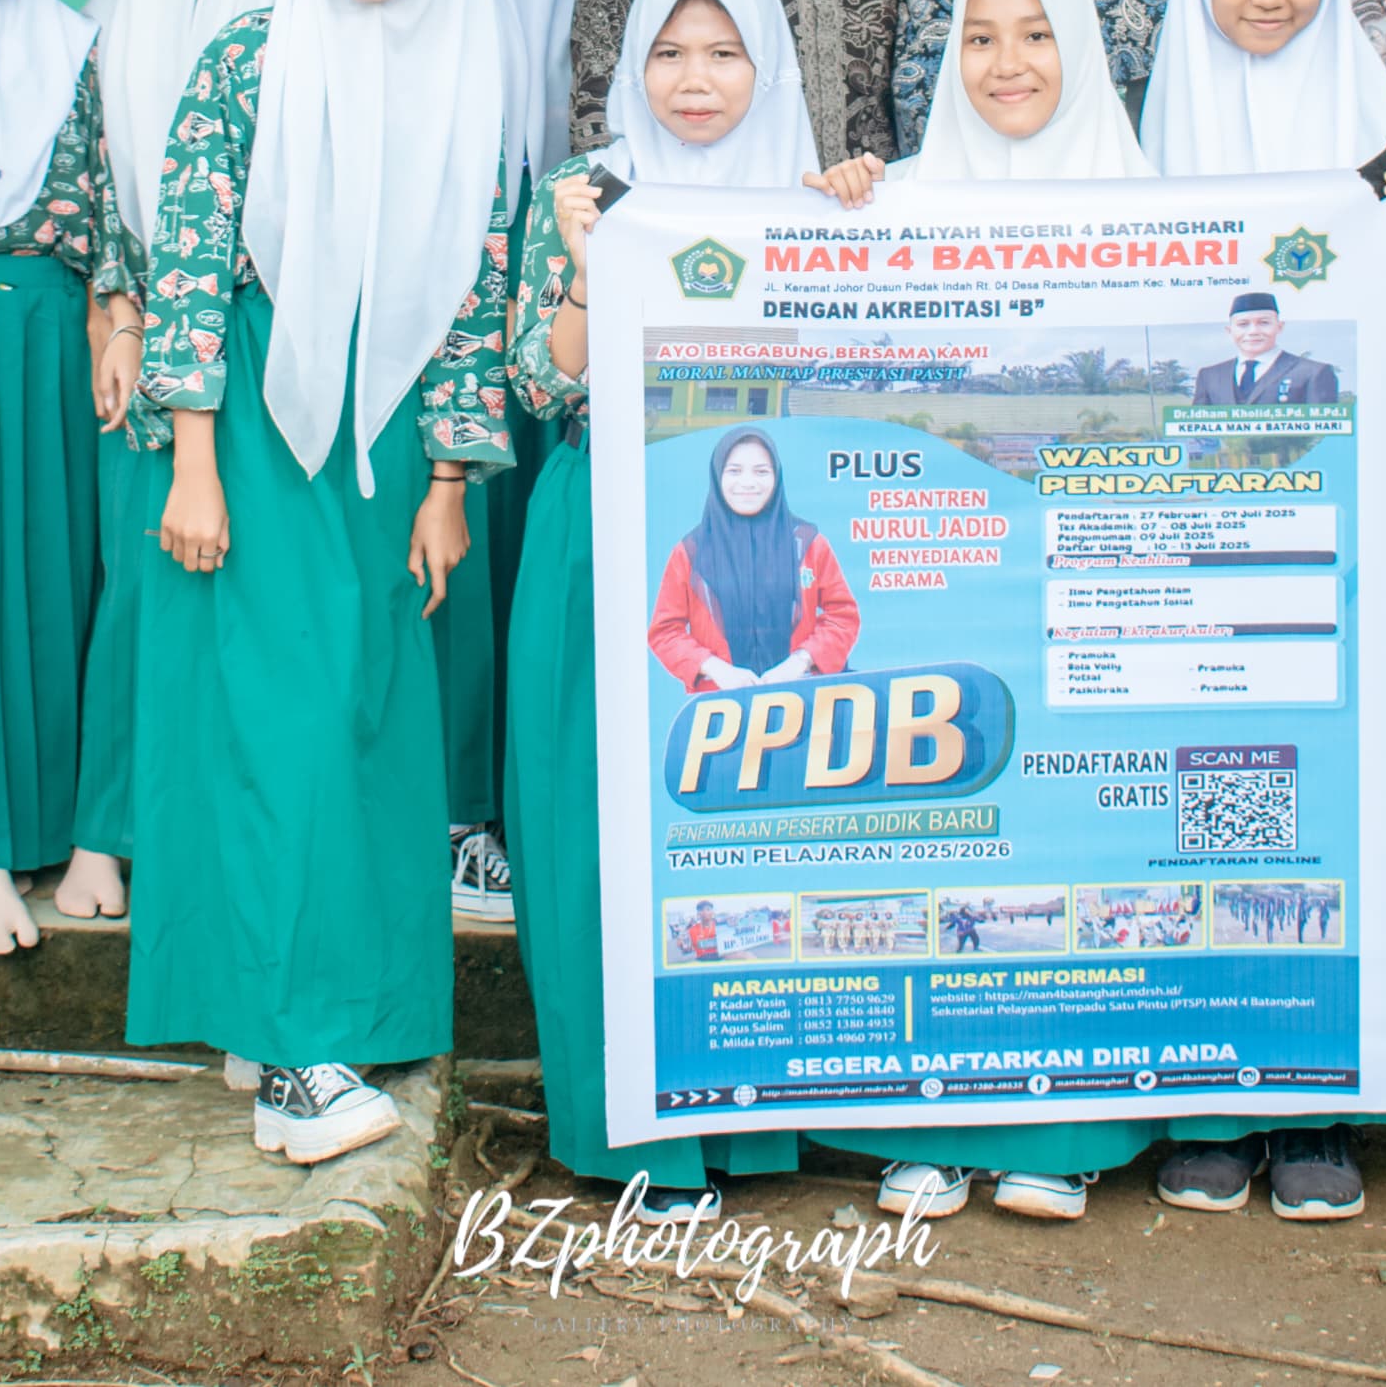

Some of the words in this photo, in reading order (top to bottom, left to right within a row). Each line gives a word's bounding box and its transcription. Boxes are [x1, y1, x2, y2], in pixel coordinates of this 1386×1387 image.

[765, 227, 892, 241] MADRASAH
[899, 226, 981, 240] ALIYAH
[989, 224, 1072, 239] NEGERI
[1080, 223, 1093, 237] 4
[1101, 220, 1245, 237] BATANGHARI
[765, 245, 869, 272] MAN
[886, 245, 915, 271] 4
[933, 239, 1239, 271] BATANGHARI
[784, 283, 830, 293] Keramat
[833, 282, 863, 293] Johor
[867, 282, 901, 293] Dusun
[943, 281, 972, 291] Indah
[995, 281, 1008, 291] 04
[1012, 280, 1039, 291] Desa
[1043, 279, 1098, 290] Rambutan
[1101, 278, 1140, 289] Masam
[1144, 277, 1165, 288] Kec.
[1170, 276, 1203, 287] Muara
[763, 300, 858, 319] DENGAN
[865, 299, 1001, 319] AKREDITASI
[659, 345, 700, 359] AYO
[706, 345, 829, 359] BERGABUNG
[835, 345, 931, 360] BERSAMA
[936, 346, 989, 359] KAMI
[658, 366, 728, 381] MORAL
[732, 366, 814, 381] MANTAP
[818, 366, 906, 381] PRESTASI
[910, 366, 965, 381] PASTI
[1178, 423, 1223, 433] KEPALA
[1226, 423, 1251, 432] MAN
[1254, 423, 1262, 431] 4
[1265, 422, 1311, 432] BATANG
[1315, 421, 1343, 431] HARI
[1040, 446, 1181, 468] WAKTU
[829, 452, 923, 478] PLUS
[1039, 471, 1322, 495] PENDAFTARAN
[869, 490, 987, 509] PESANTREN
[1057, 512, 1130, 521] Pendaftaran
[1139, 511, 1155, 519] 27
[1158, 510, 1208, 519] Februari
[1240, 509, 1262, 518] Juli
[1265, 509, 1297, 518] 2025
[852, 518, 931, 540] NURUL
[937, 517, 1007, 538] JADID
[1190, 521, 1212, 530] Juli
[1215, 521, 1246, 530] 2025
[1159, 532, 1180, 541] Juli
[1184, 531, 1215, 540] 2025
[1057, 543, 1096, 552] Daftar
[1099, 543, 1133, 554] Ulang
[1154, 542, 1168, 551] 10
[1180, 542, 1192, 551] 13
[1195, 541, 1216, 550] Juli
[1219, 541, 1250, 550] 2025
[870, 548, 999, 565] MENYEDIAKAN
[1053, 555, 1116, 568] Program
[870, 572, 945, 588] ASRAMA
[1068, 587, 1093, 596] Ilmu
[1164, 586, 1191, 595] Alam
[1068, 599, 1093, 608] Ilmu
[1068, 651, 1116, 660] Pramuka
[1068, 663, 1091, 671] Bola
[1197, 664, 1246, 673] Pramuka
[1200, 683, 1248, 693] Pramuka
[677, 673, 966, 795] PPDB
[1023, 751, 1168, 775] PENDAFTARAN
[1189, 750, 1243, 765] SCAN
[1251, 750, 1281, 764] ME
[1098, 785, 1169, 808] GRATIS
[668, 820, 772, 843] PENERIMAAN
[776, 815, 862, 837] PESERTA
[865, 811, 922, 834] DIDIK
[928, 808, 994, 832] BARU
[669, 851, 744, 868] TAHUN
[753, 844, 893, 864] PELAJARAN
[900, 841, 1010, 860] 2025/2026
[1148, 856, 1259, 867] PENDAFTARAN
[1263, 855, 1322, 865] ONLINE
[930, 971, 1009, 990] PUSAT
[1015, 967, 1146, 987] INFORMASI
[712, 976, 880, 997] NARAHUBUNG
[720, 999, 754, 1010] Kadar
[756, 997, 786, 1009] Yasin
[836, 995, 864, 1006] 7750
[930, 991, 976, 1003] website
[931, 1005, 995, 1017] Sekretariat
[997, 1003, 1057, 1017] Pelayanan
[1060, 1001, 1107, 1015] Terpadu
[1109, 1000, 1135, 1011] Satu
[1137, 999, 1168, 1010] Pintu
[1171, 997, 1206, 1010] (PTSP)
[1209, 997, 1238, 1007] MAN
[1241, 997, 1248, 1007] 4
[1250, 996, 1316, 1008] Batanghari
[720, 1024, 749, 1036] Agus
[752, 1022, 784, 1033] Salim
[723, 1037, 755, 1048] Milda
[786, 1055, 902, 1077] SEGERA
[911, 1048, 1084, 1073] DAFTARKAN
[1092, 1045, 1150, 1066] DIRI
[1159, 1043, 1239, 1064] ANDA
